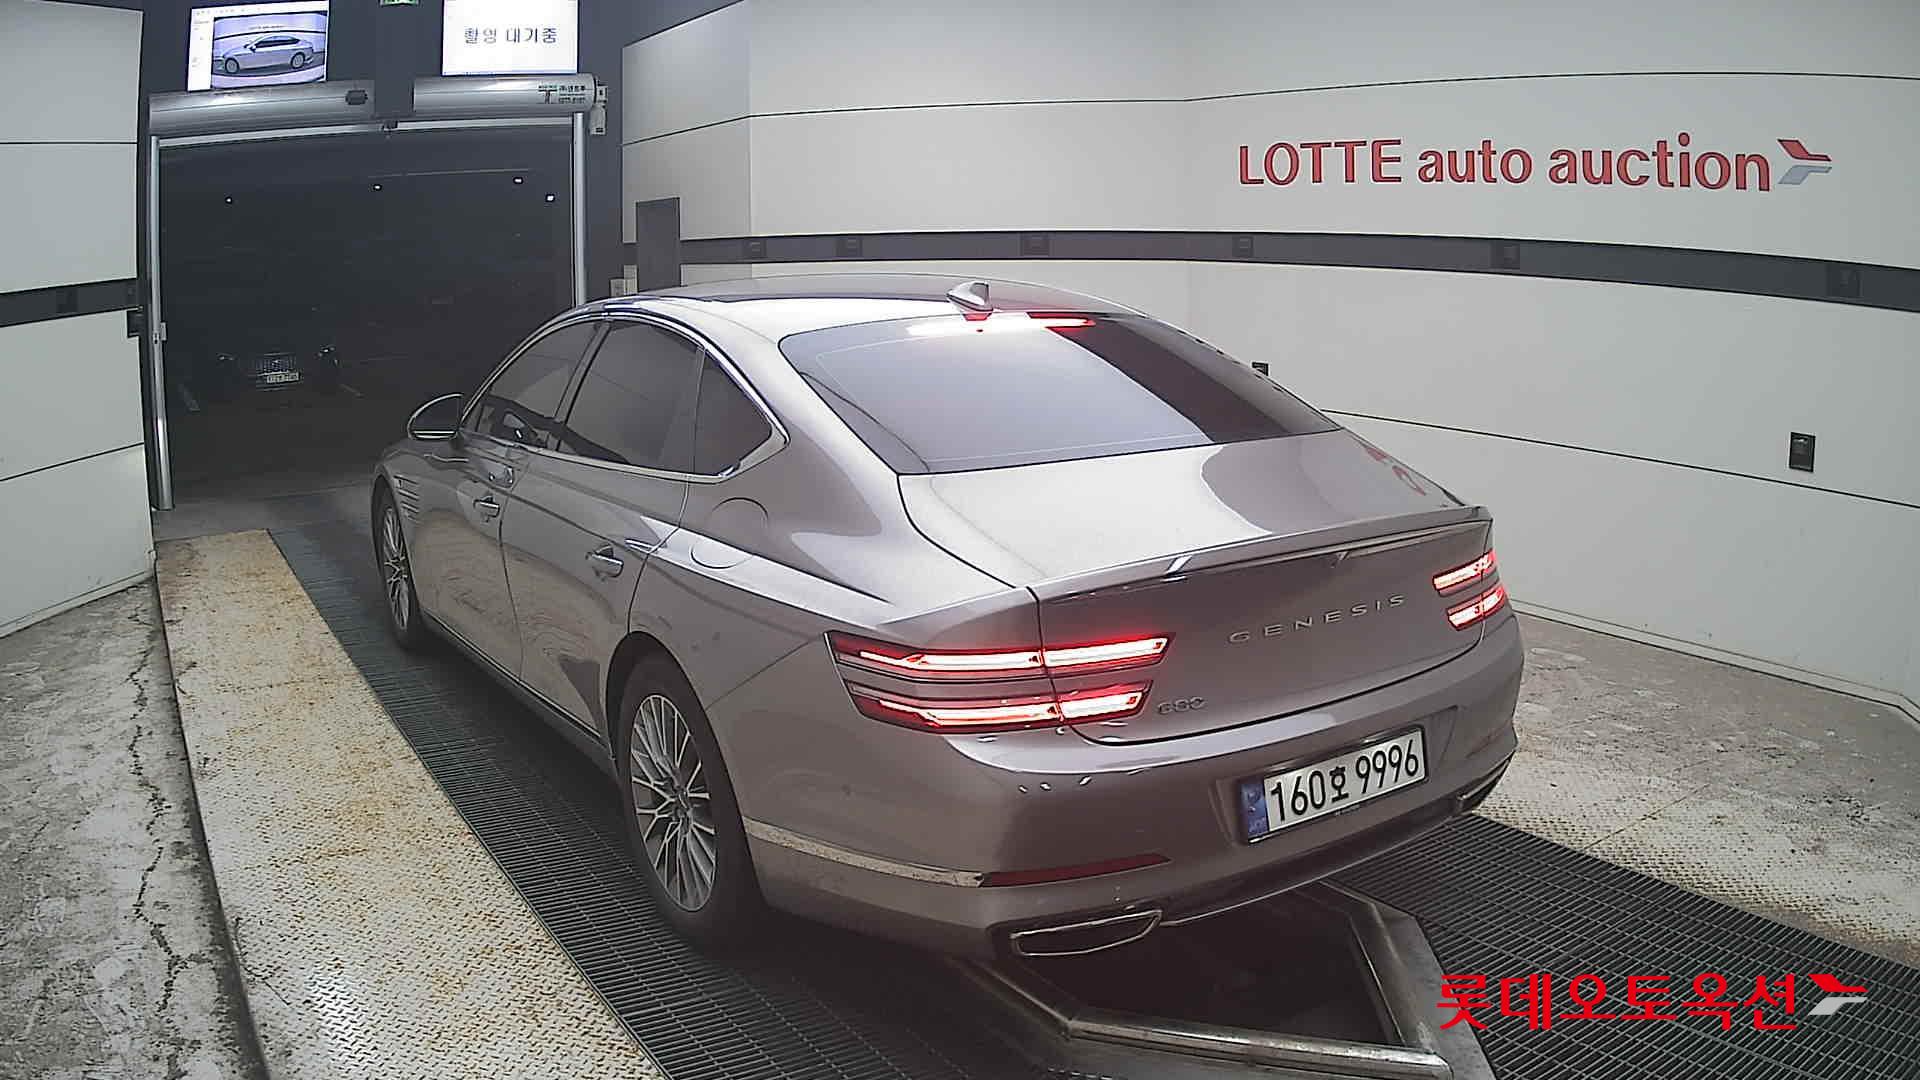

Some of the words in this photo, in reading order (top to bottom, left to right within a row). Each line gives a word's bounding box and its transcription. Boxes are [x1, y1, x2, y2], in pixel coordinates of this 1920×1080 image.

[506, 27, 557, 44] 대기중
[1239, 139, 1401, 185] LOTTE
[1418, 140, 1532, 184] auto
[1548, 132, 1771, 192] auction
[1229, 594, 1404, 644] GENESIS
[1271, 766, 1349, 822] 160호
[1355, 739, 1419, 794] 9996
